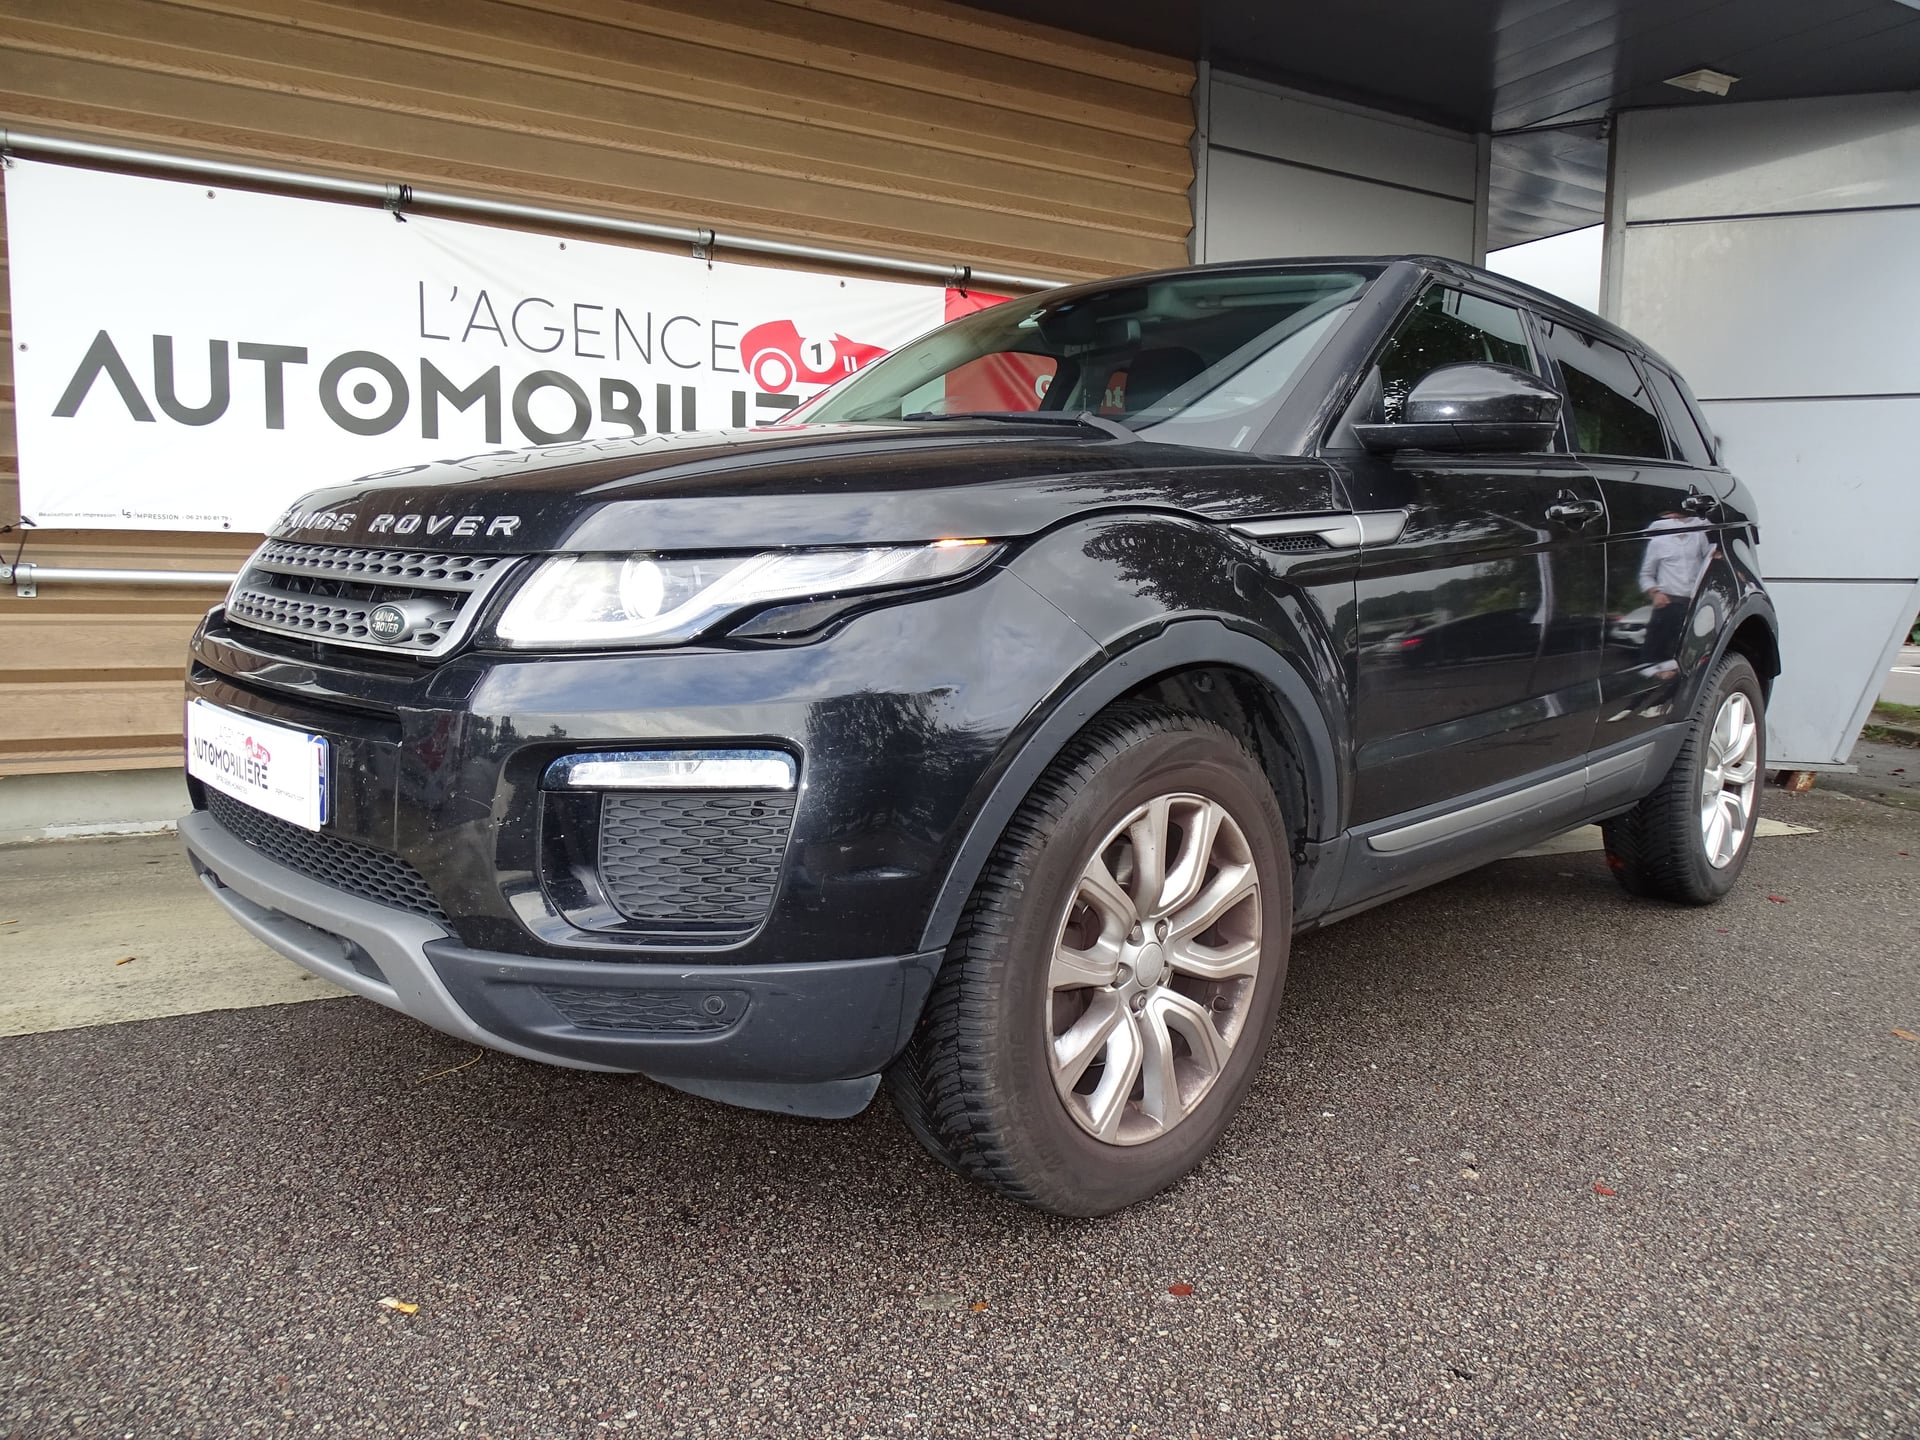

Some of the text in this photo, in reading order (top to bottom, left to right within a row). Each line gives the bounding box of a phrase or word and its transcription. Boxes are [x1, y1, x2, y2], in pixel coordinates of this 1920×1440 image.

[418, 280, 741, 375] L'AGENCE
[810, 342, 822, 366] 1
[368, 513, 522, 537] ROVER
[374, 621, 399, 633] ROVER
[375, 611, 395, 622] LAND
